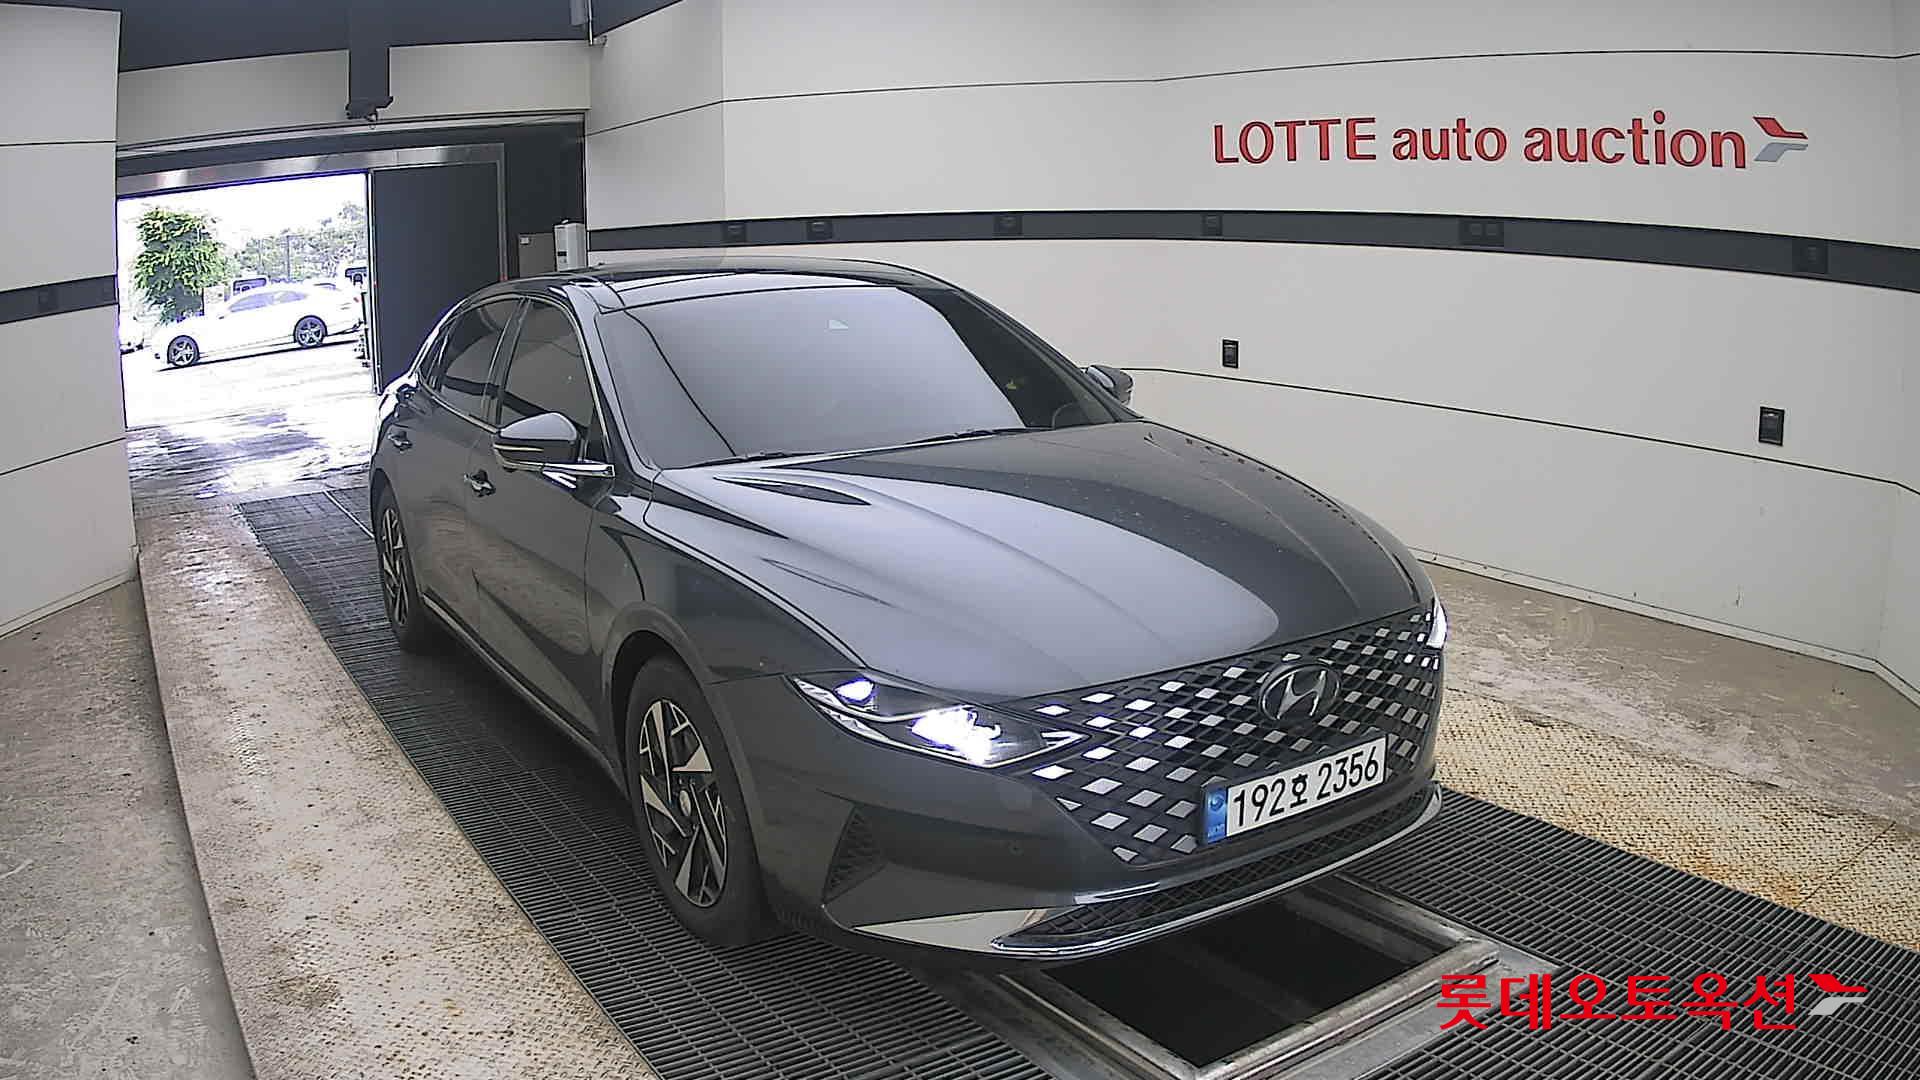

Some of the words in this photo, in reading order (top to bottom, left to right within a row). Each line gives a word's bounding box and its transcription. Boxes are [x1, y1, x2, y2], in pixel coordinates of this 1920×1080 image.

[1213, 117, 1376, 164] LOTTE
[1392, 118, 1507, 161] auto
[1523, 110, 1746, 169] auction
[1233, 773, 1309, 827] 192호
[1316, 746, 1379, 800] 2356
